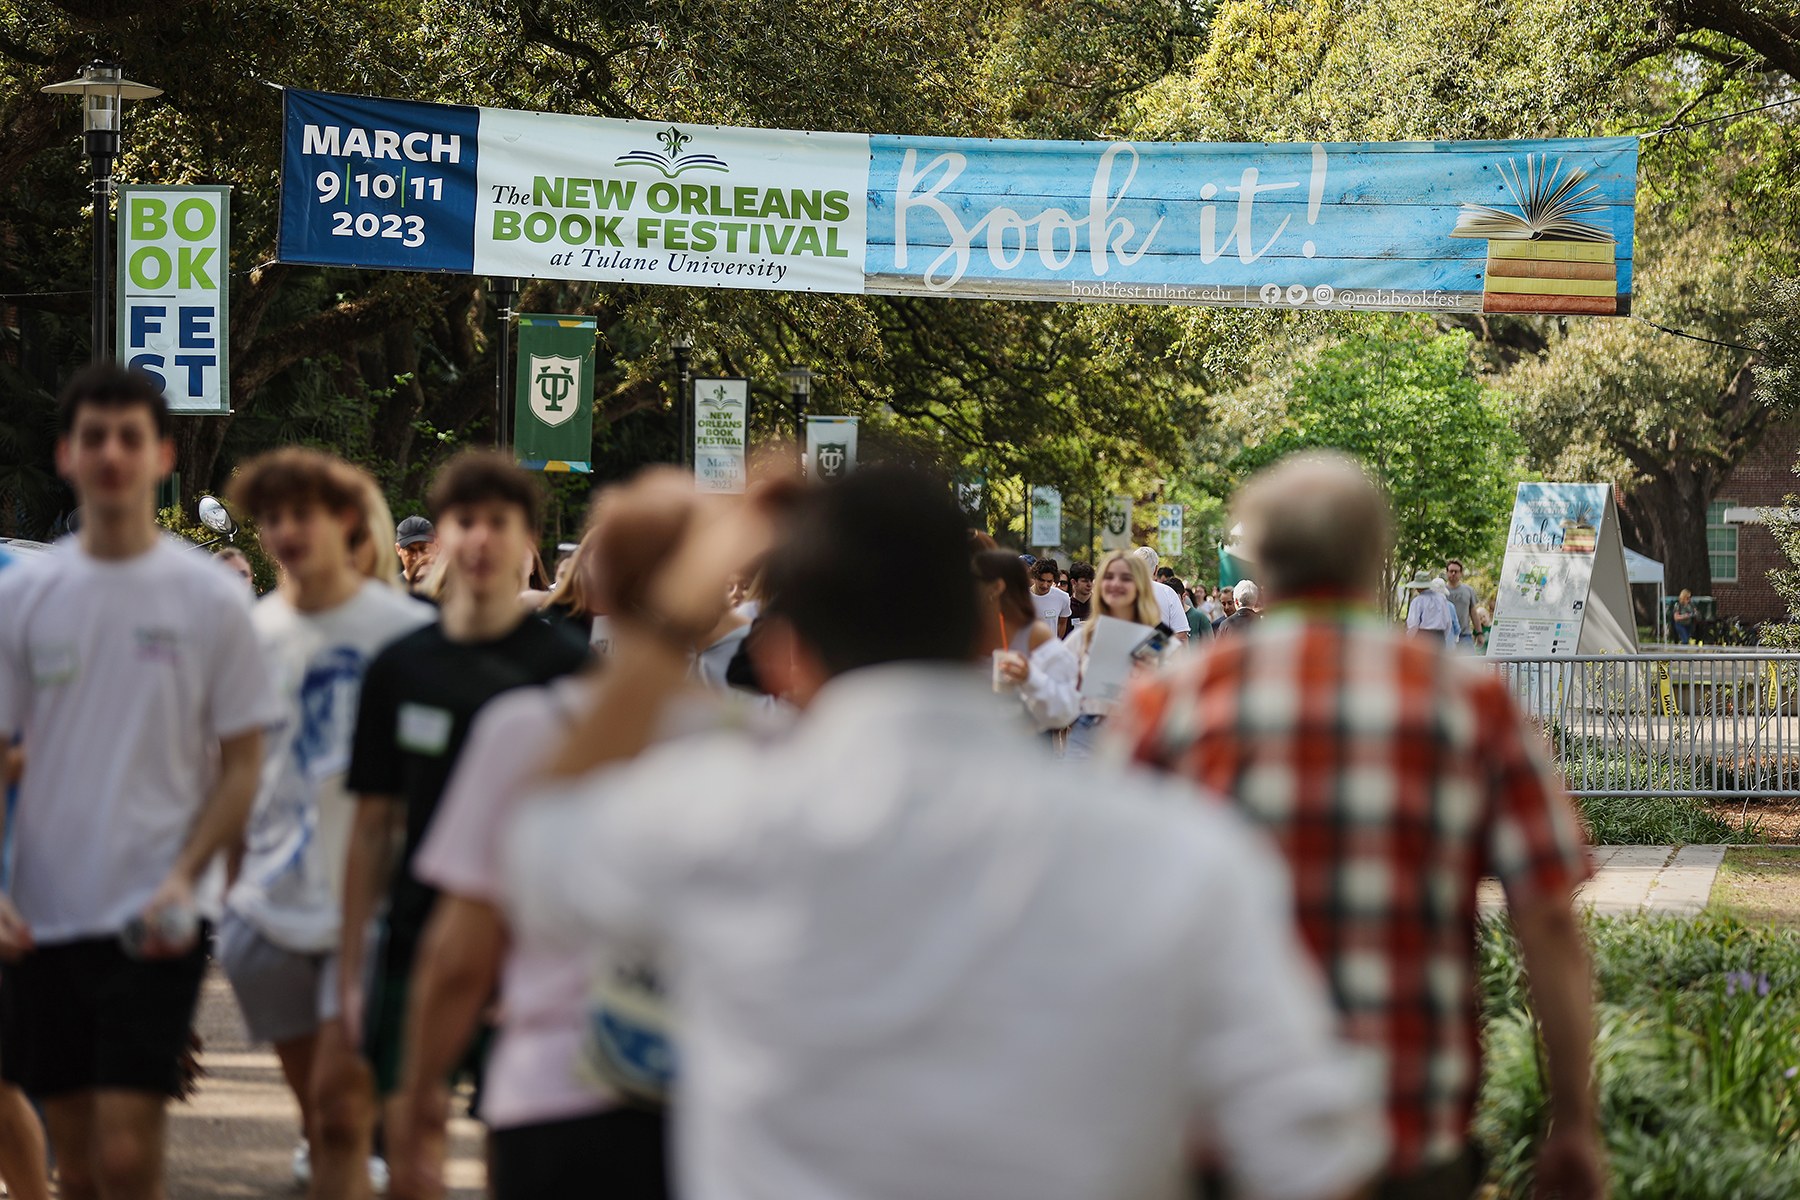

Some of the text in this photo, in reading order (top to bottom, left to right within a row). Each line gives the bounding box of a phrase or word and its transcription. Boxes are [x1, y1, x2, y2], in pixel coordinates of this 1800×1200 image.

[302, 124, 461, 164] MARCH
[491, 175, 850, 222] The NEW ORLEANS
[894, 141, 1328, 291] Book it!
[130, 197, 217, 242] BO
[331, 211, 426, 248] 2023
[492, 209, 849, 258] BOOK FESTIVAL
[128, 246, 218, 290] OK
[550, 248, 788, 284] at Tulane University
[1070, 280, 1462, 307] bookfest.tulane.edu @nolabookfest
[130, 305, 215, 349] FE
[697, 436, 742, 445] FESTIVAL
[698, 420, 742, 428] ORLEANS
[706, 428, 733, 436] BOOK
[707, 457, 736, 467] March
[1513, 518, 1549, 548] Book
